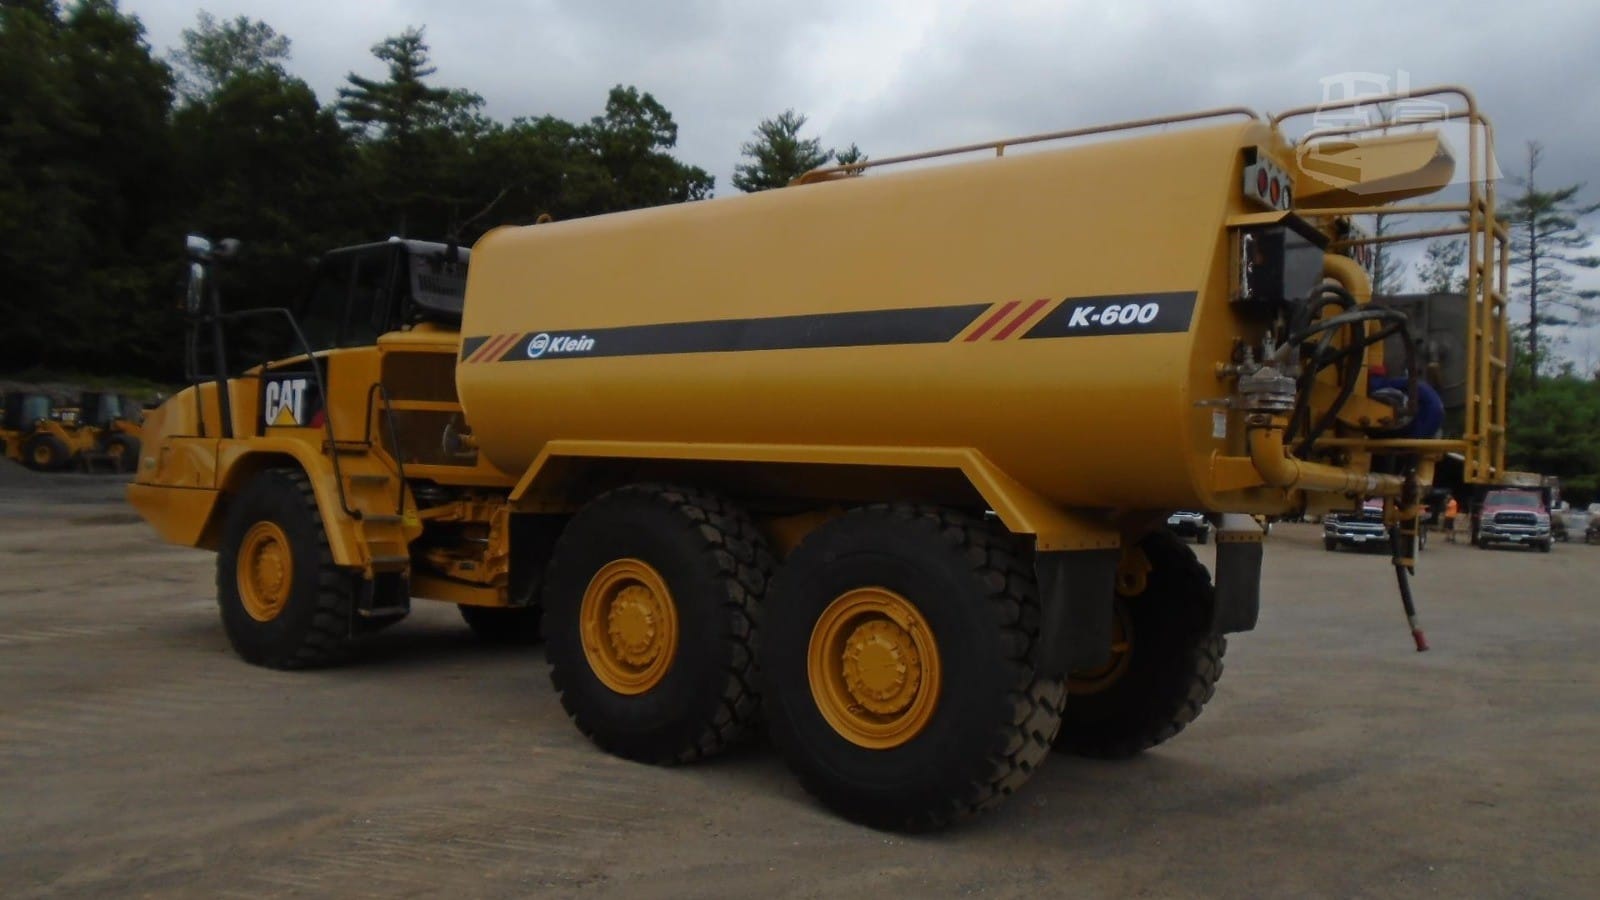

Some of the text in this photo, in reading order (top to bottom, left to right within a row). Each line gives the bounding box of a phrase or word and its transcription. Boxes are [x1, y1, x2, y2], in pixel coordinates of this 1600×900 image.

[1068, 303, 1160, 327] K-600
[547, 335, 595, 352] Klein
[265, 379, 306, 426] CAT
